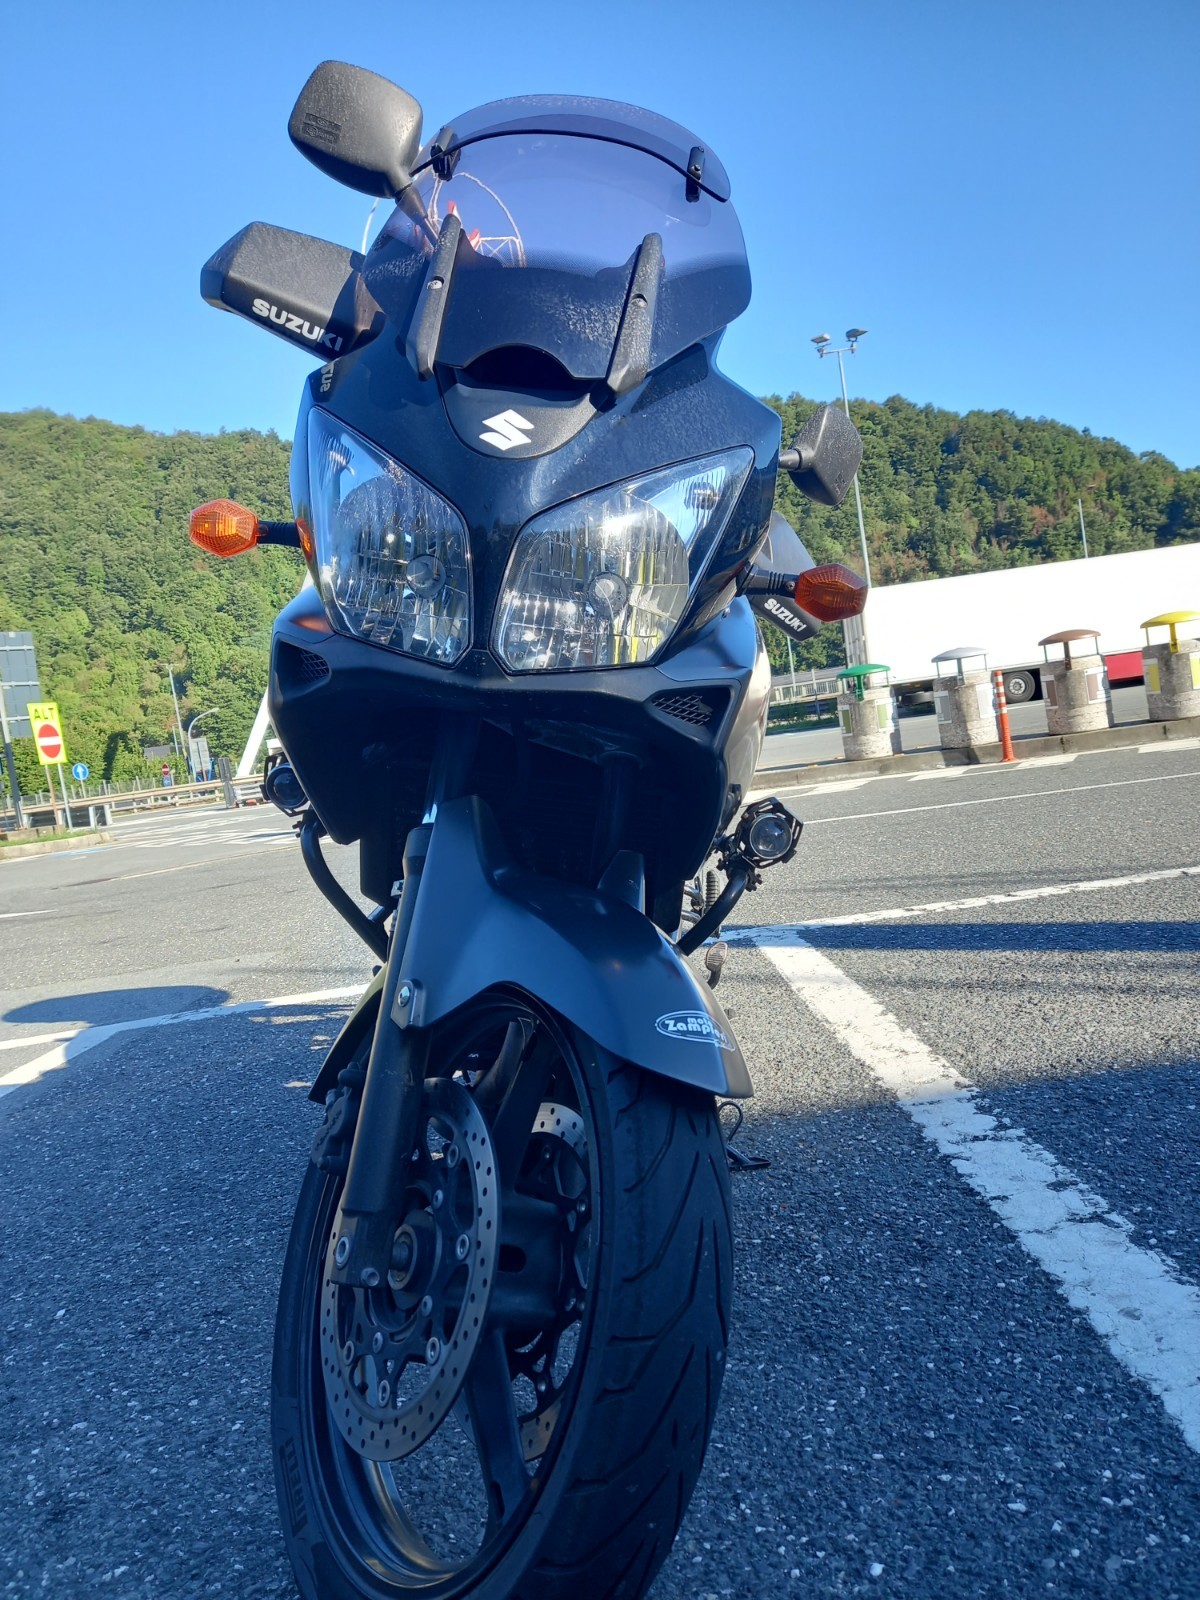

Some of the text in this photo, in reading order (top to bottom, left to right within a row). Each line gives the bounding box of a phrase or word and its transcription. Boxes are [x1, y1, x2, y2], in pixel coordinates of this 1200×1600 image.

[252, 298, 343, 352] SUZUKI
[764, 598, 808, 632] SUZUKI
[34, 707, 54, 720] ALT
[278, 1438, 309, 1538] PIRELLI
